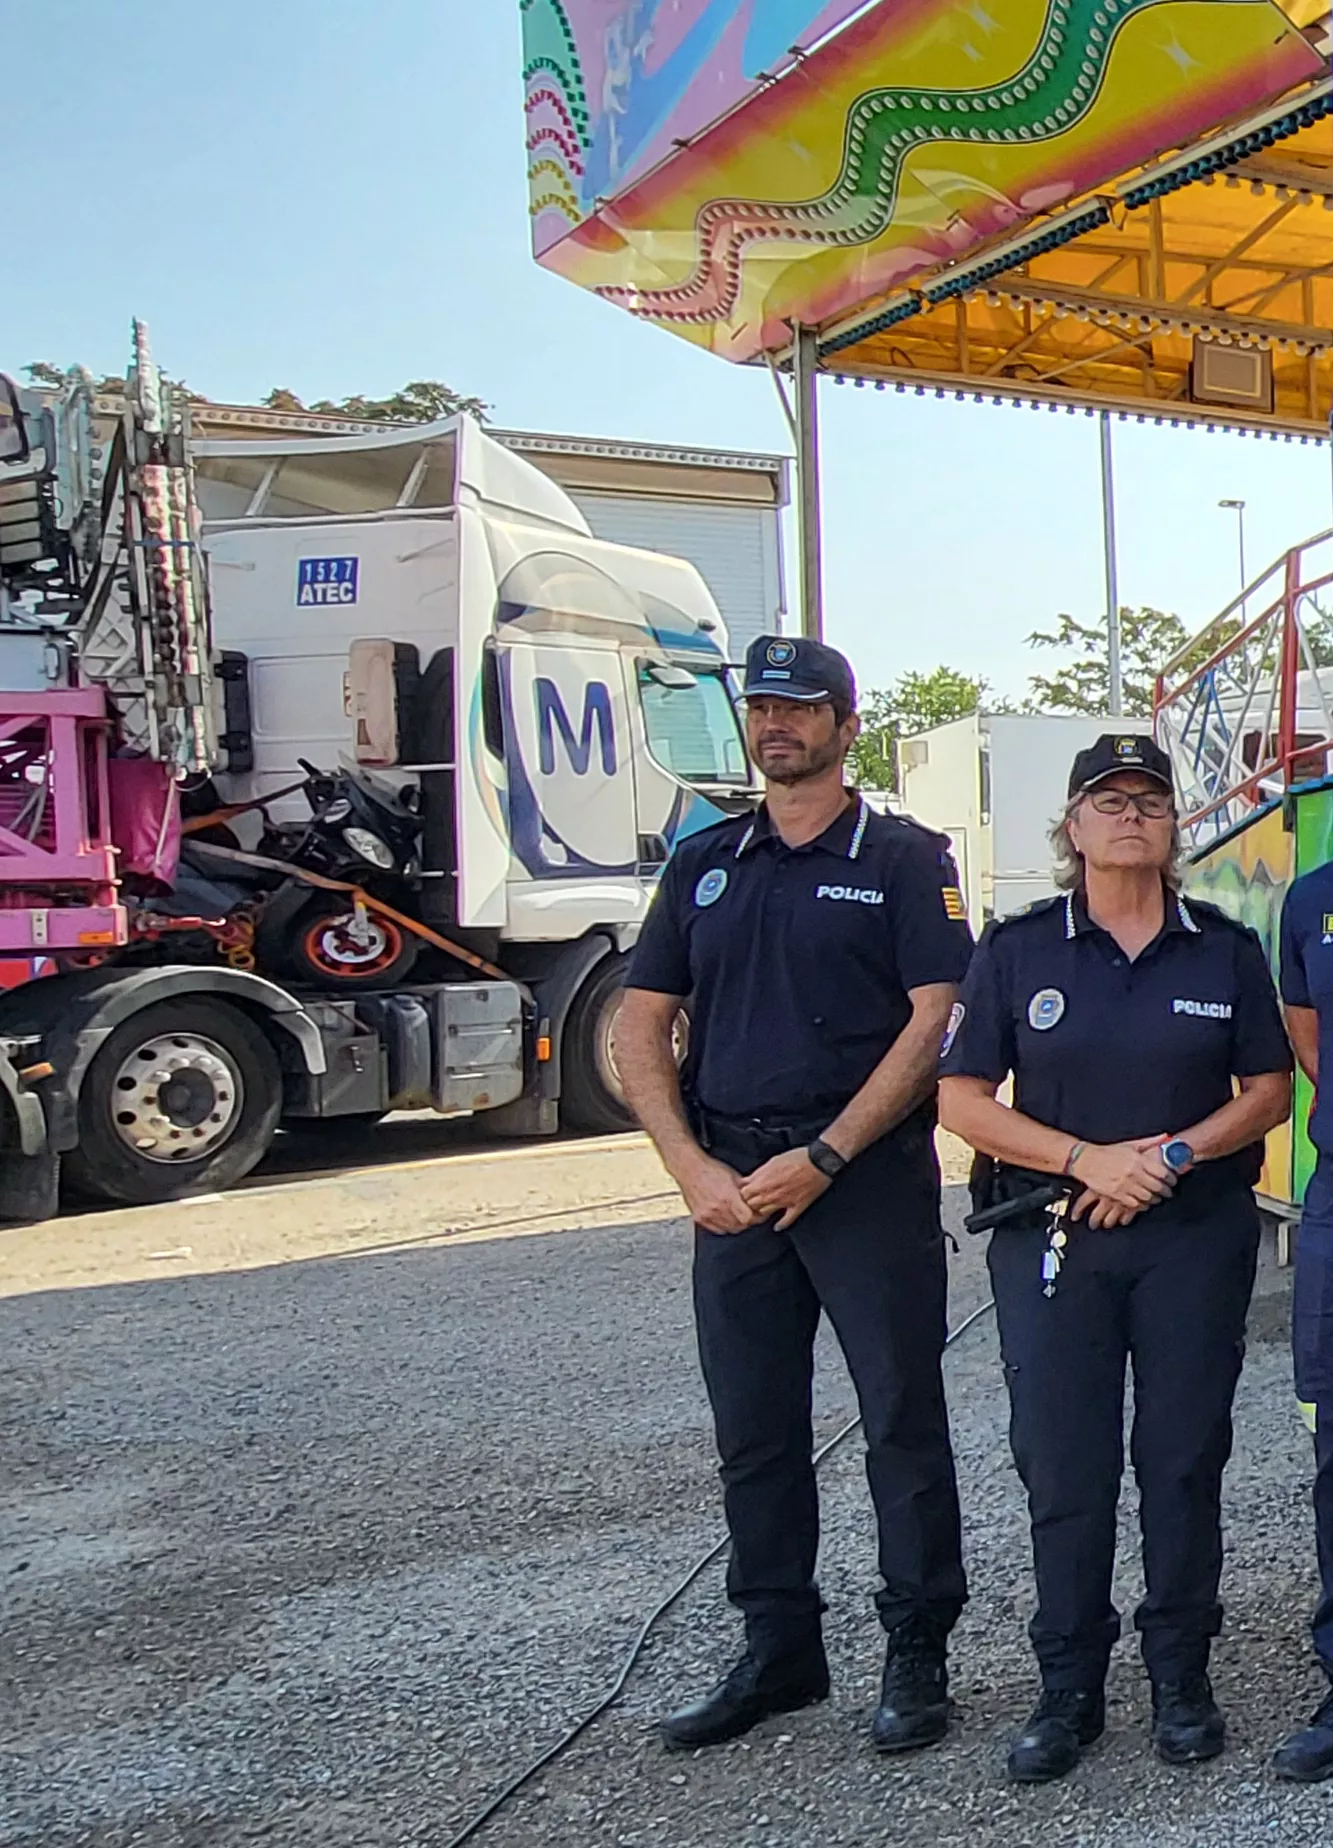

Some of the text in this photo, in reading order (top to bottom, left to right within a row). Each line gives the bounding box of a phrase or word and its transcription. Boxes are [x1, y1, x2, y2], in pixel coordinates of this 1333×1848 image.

[305, 560, 353, 581] 1527
[300, 581, 354, 604] ATEC
[533, 677, 618, 777] M
[816, 885, 885, 904] POLICIA
[1173, 999, 1233, 1020] POLICIA
